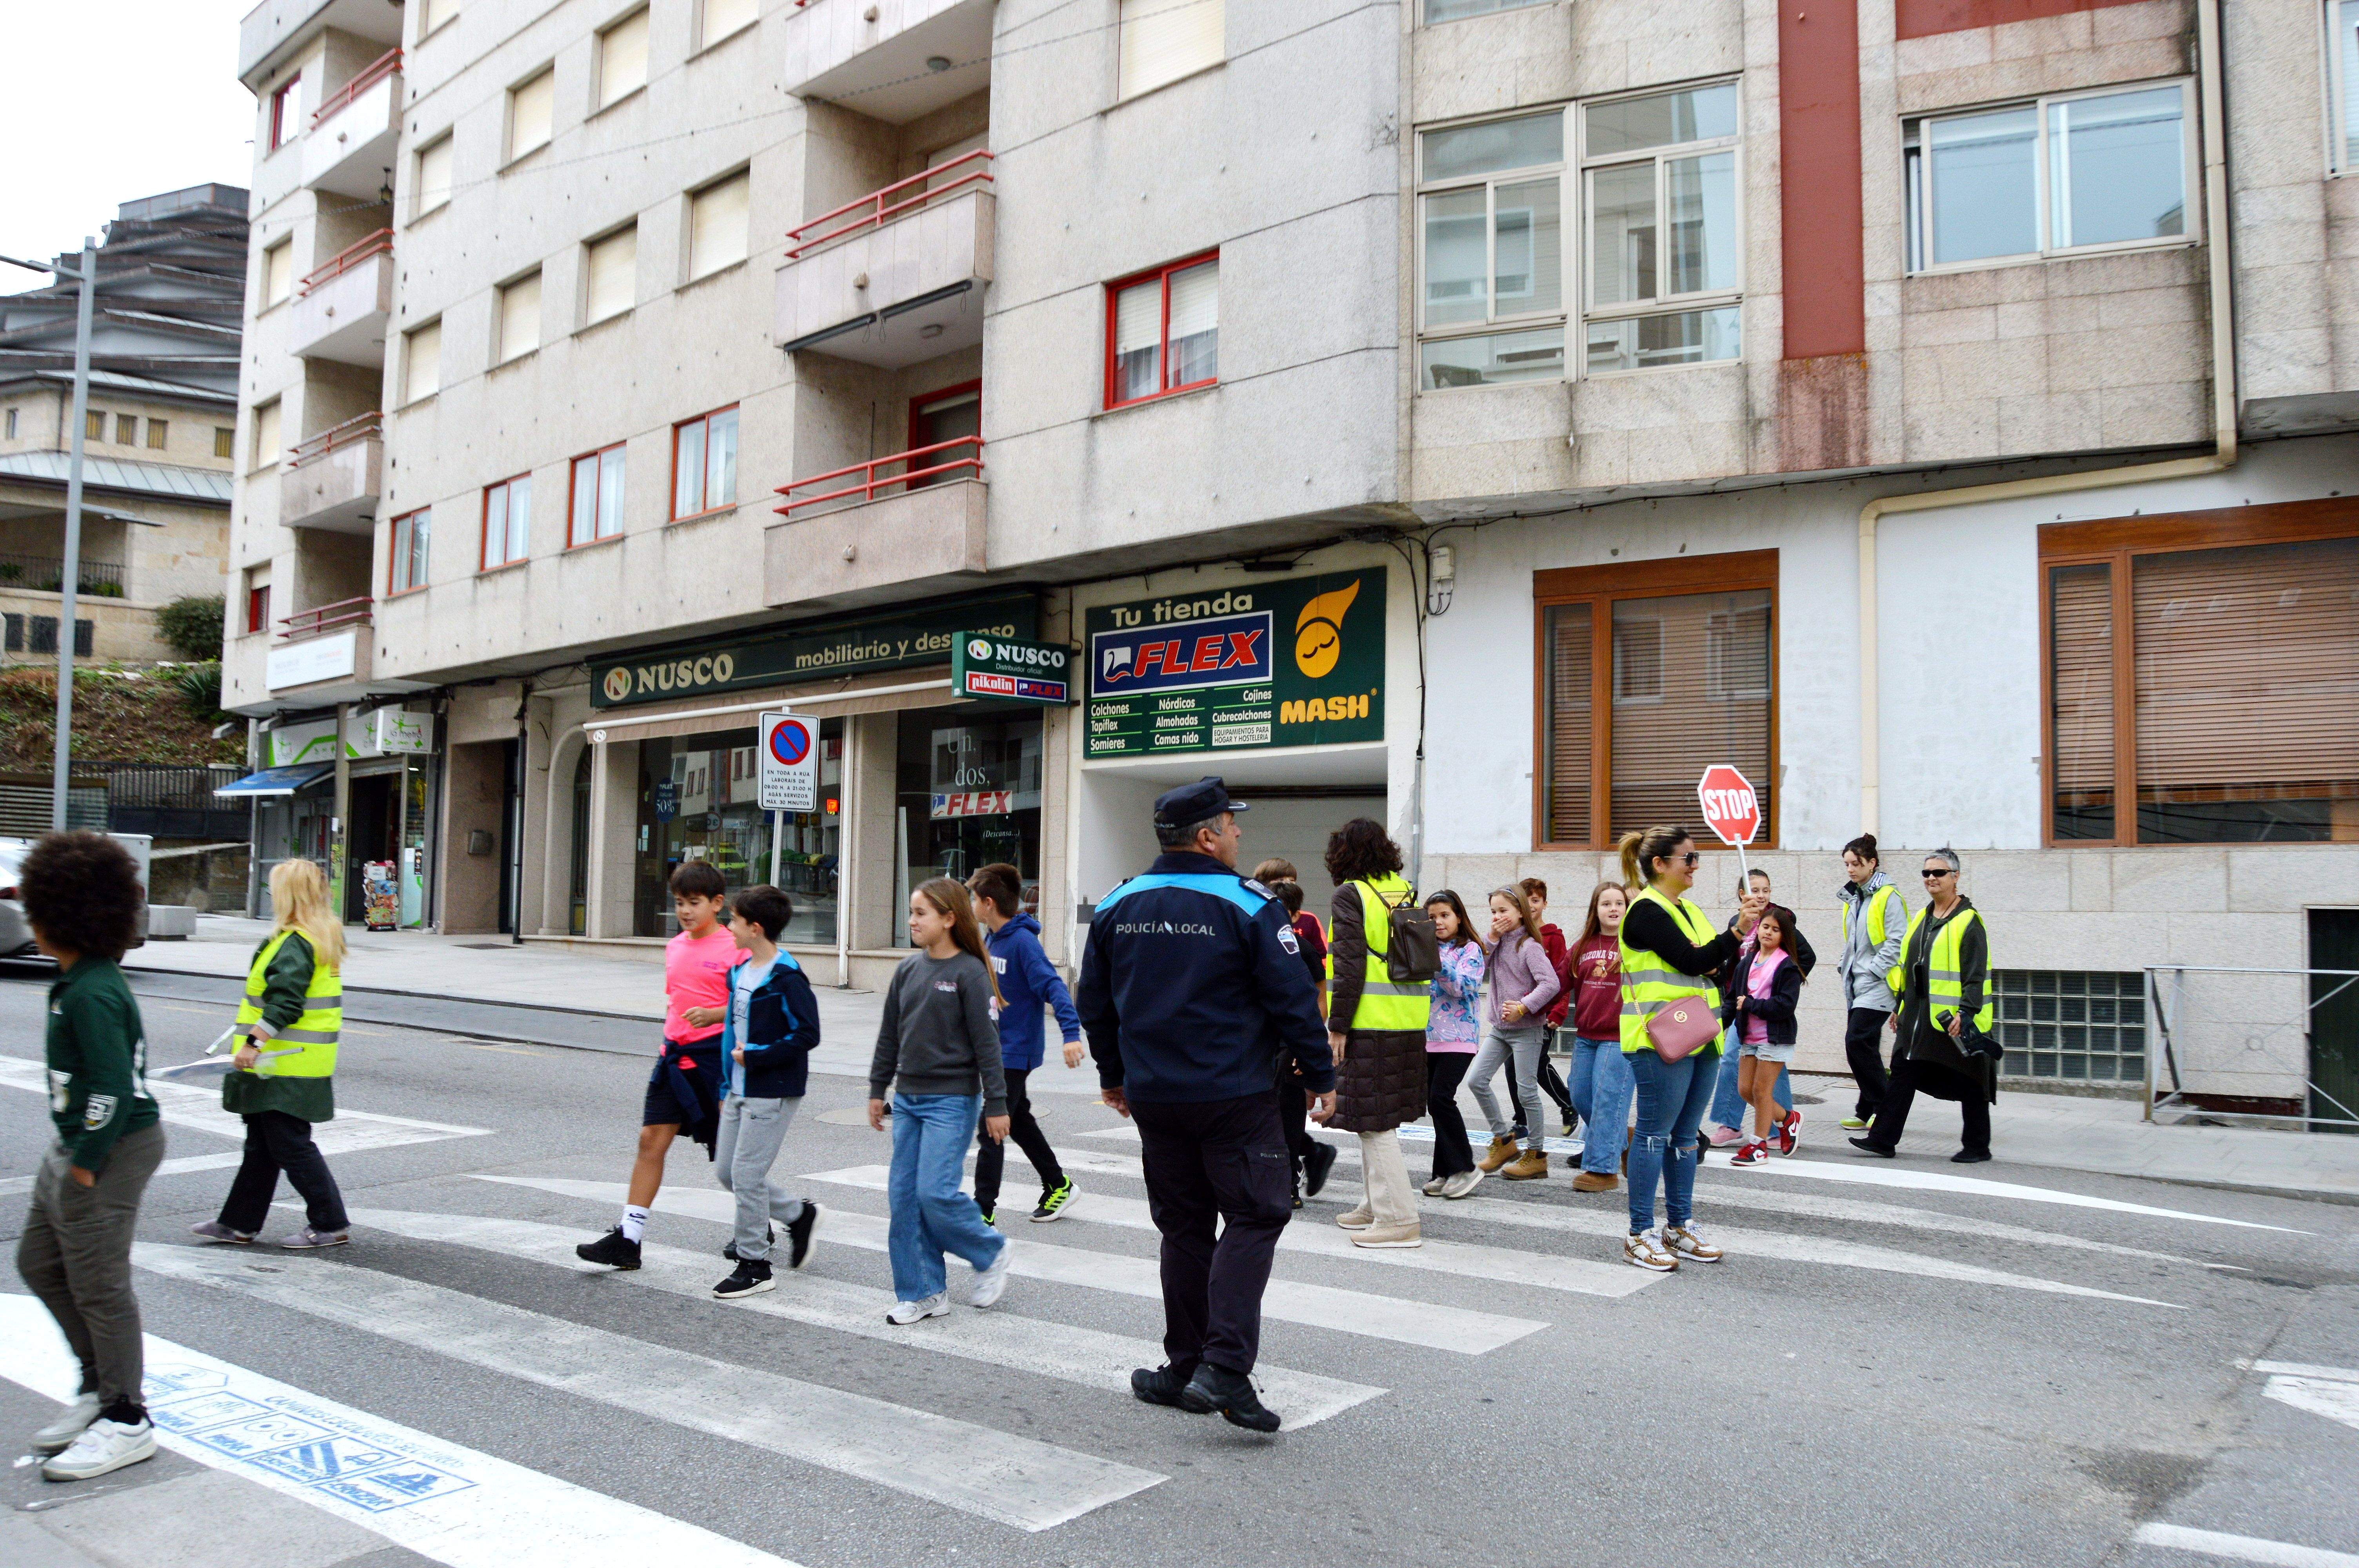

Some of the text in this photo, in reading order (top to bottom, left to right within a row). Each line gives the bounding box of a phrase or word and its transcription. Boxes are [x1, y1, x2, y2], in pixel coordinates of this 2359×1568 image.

[1111, 592, 1253, 627] Tu tienda
[796, 640, 891, 668] mobiliario
[897, 640, 909, 660] y
[996, 643, 1065, 668] NUSCO
[1134, 629, 1264, 677] FLEX
[637, 653, 734, 693] NUSCO
[996, 662, 1025, 673] Distribuidor
[972, 675, 1012, 691] pikolin
[1029, 683, 1063, 697] FLEX
[1159, 697, 1195, 710] Nórdicos
[1243, 689, 1272, 703] Cojines
[1091, 703, 1129, 717] Colchones
[1212, 710, 1271, 722] Cubrecolchones
[1280, 694, 1369, 724] MASH
[1091, 719, 1118, 734] Tapiflex
[1156, 714, 1198, 727] Almohadas
[1155, 731, 1199, 745] Camas nido
[1214, 727, 1254, 736] EQUIPAMIENTOS
[1091, 737, 1125, 751] Somieres
[955, 762, 990, 786] dos,
[656, 799, 674, 814] 50%
[947, 791, 1011, 815] FLEX
[1704, 789, 1753, 820] STOP
[1116, 921, 1216, 936] POLICÍA LOCAL
